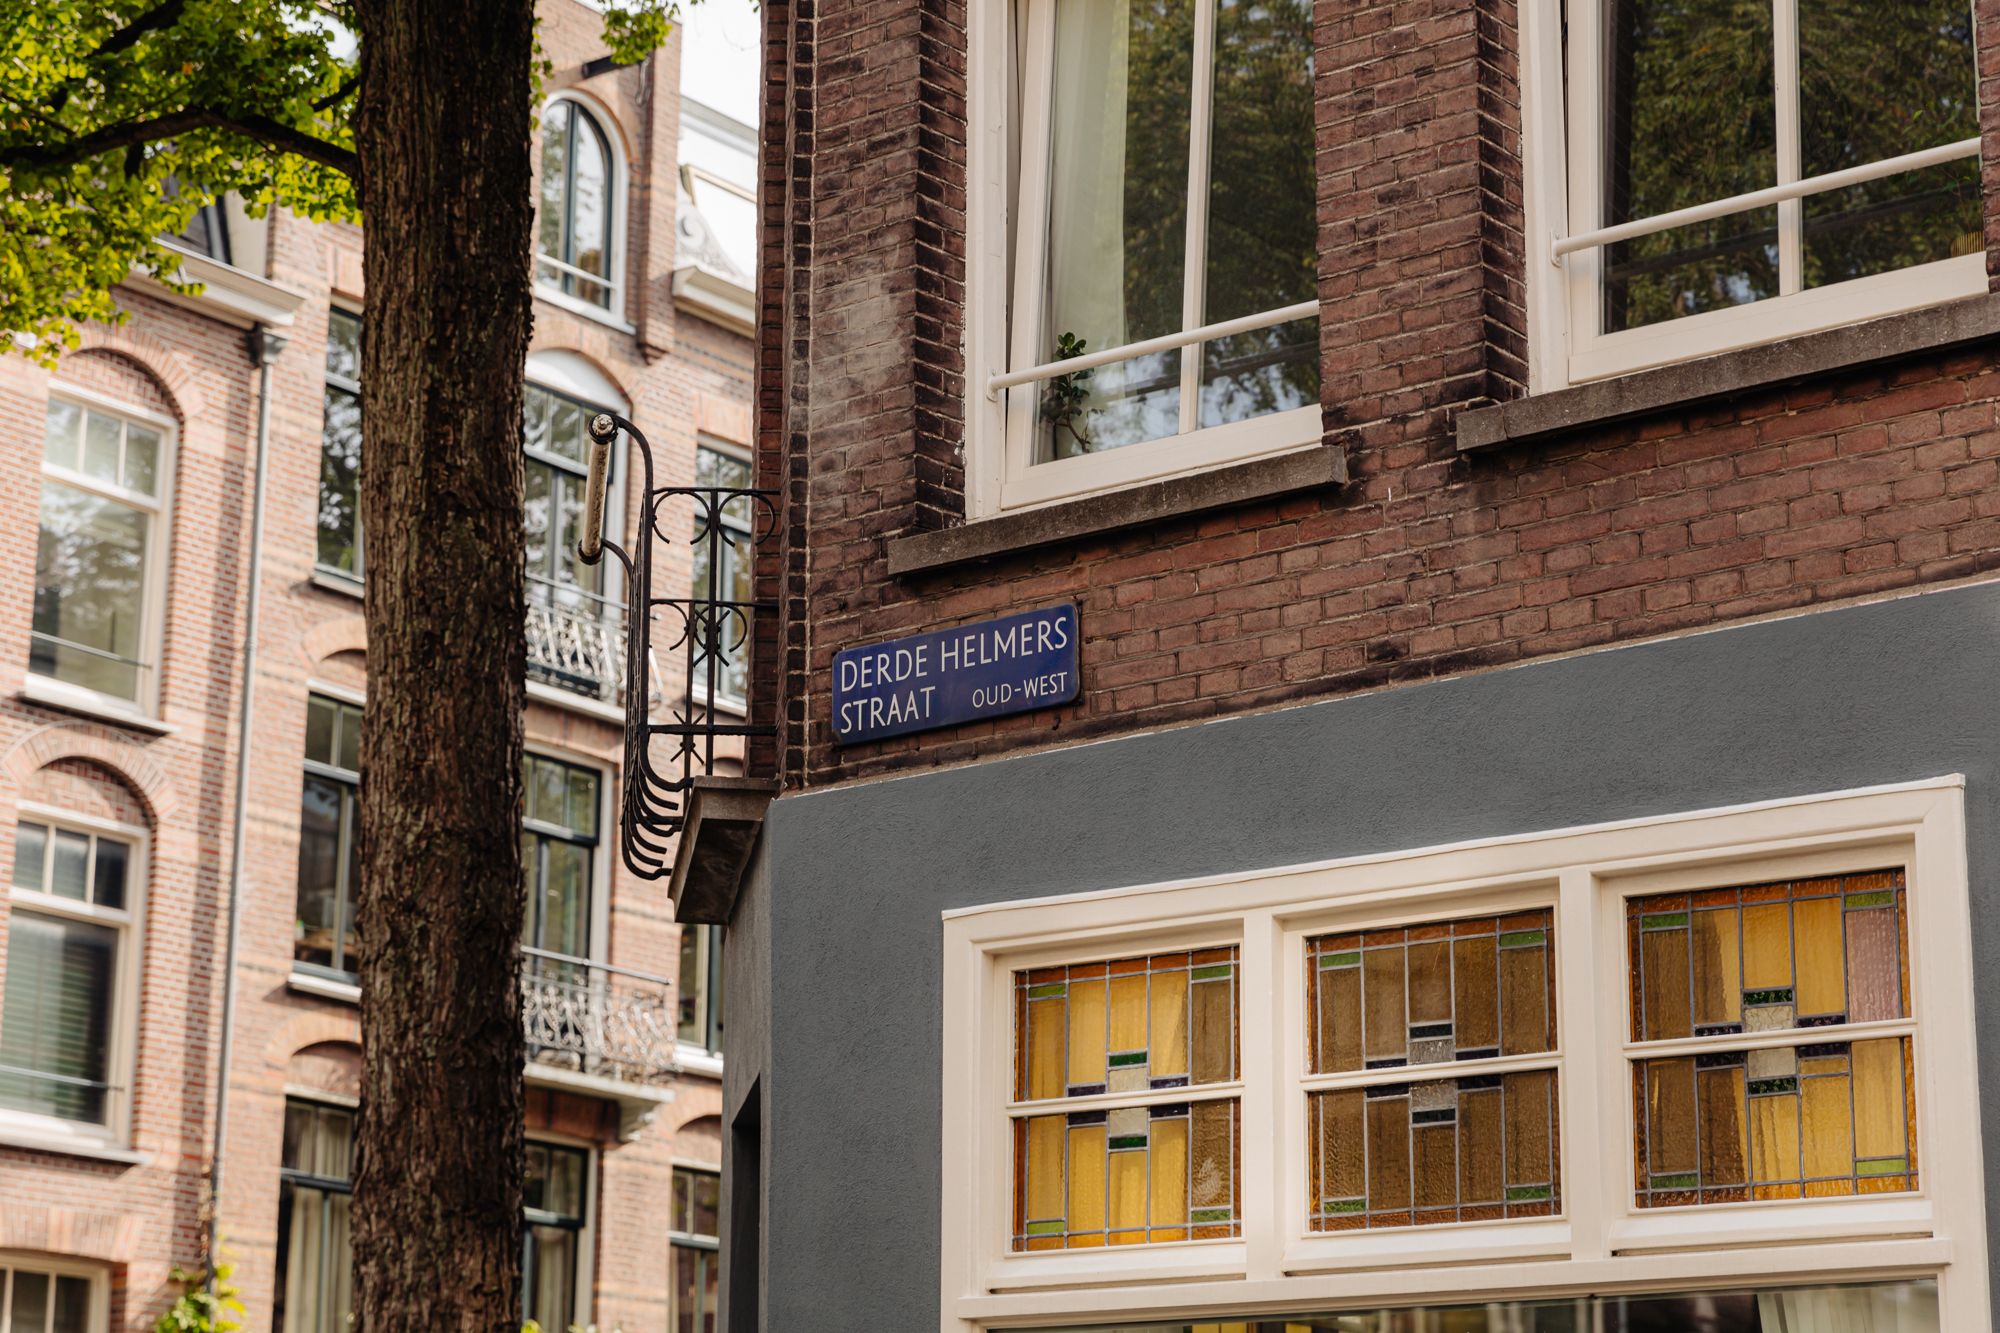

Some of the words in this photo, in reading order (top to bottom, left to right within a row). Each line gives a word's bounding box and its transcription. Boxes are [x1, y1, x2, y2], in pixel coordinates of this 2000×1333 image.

[841, 645, 928, 693] DERDE
[941, 617, 1068, 672] HELMERS
[840, 686, 936, 734] STRAAT
[972, 671, 1068, 708] OUD-WEST
